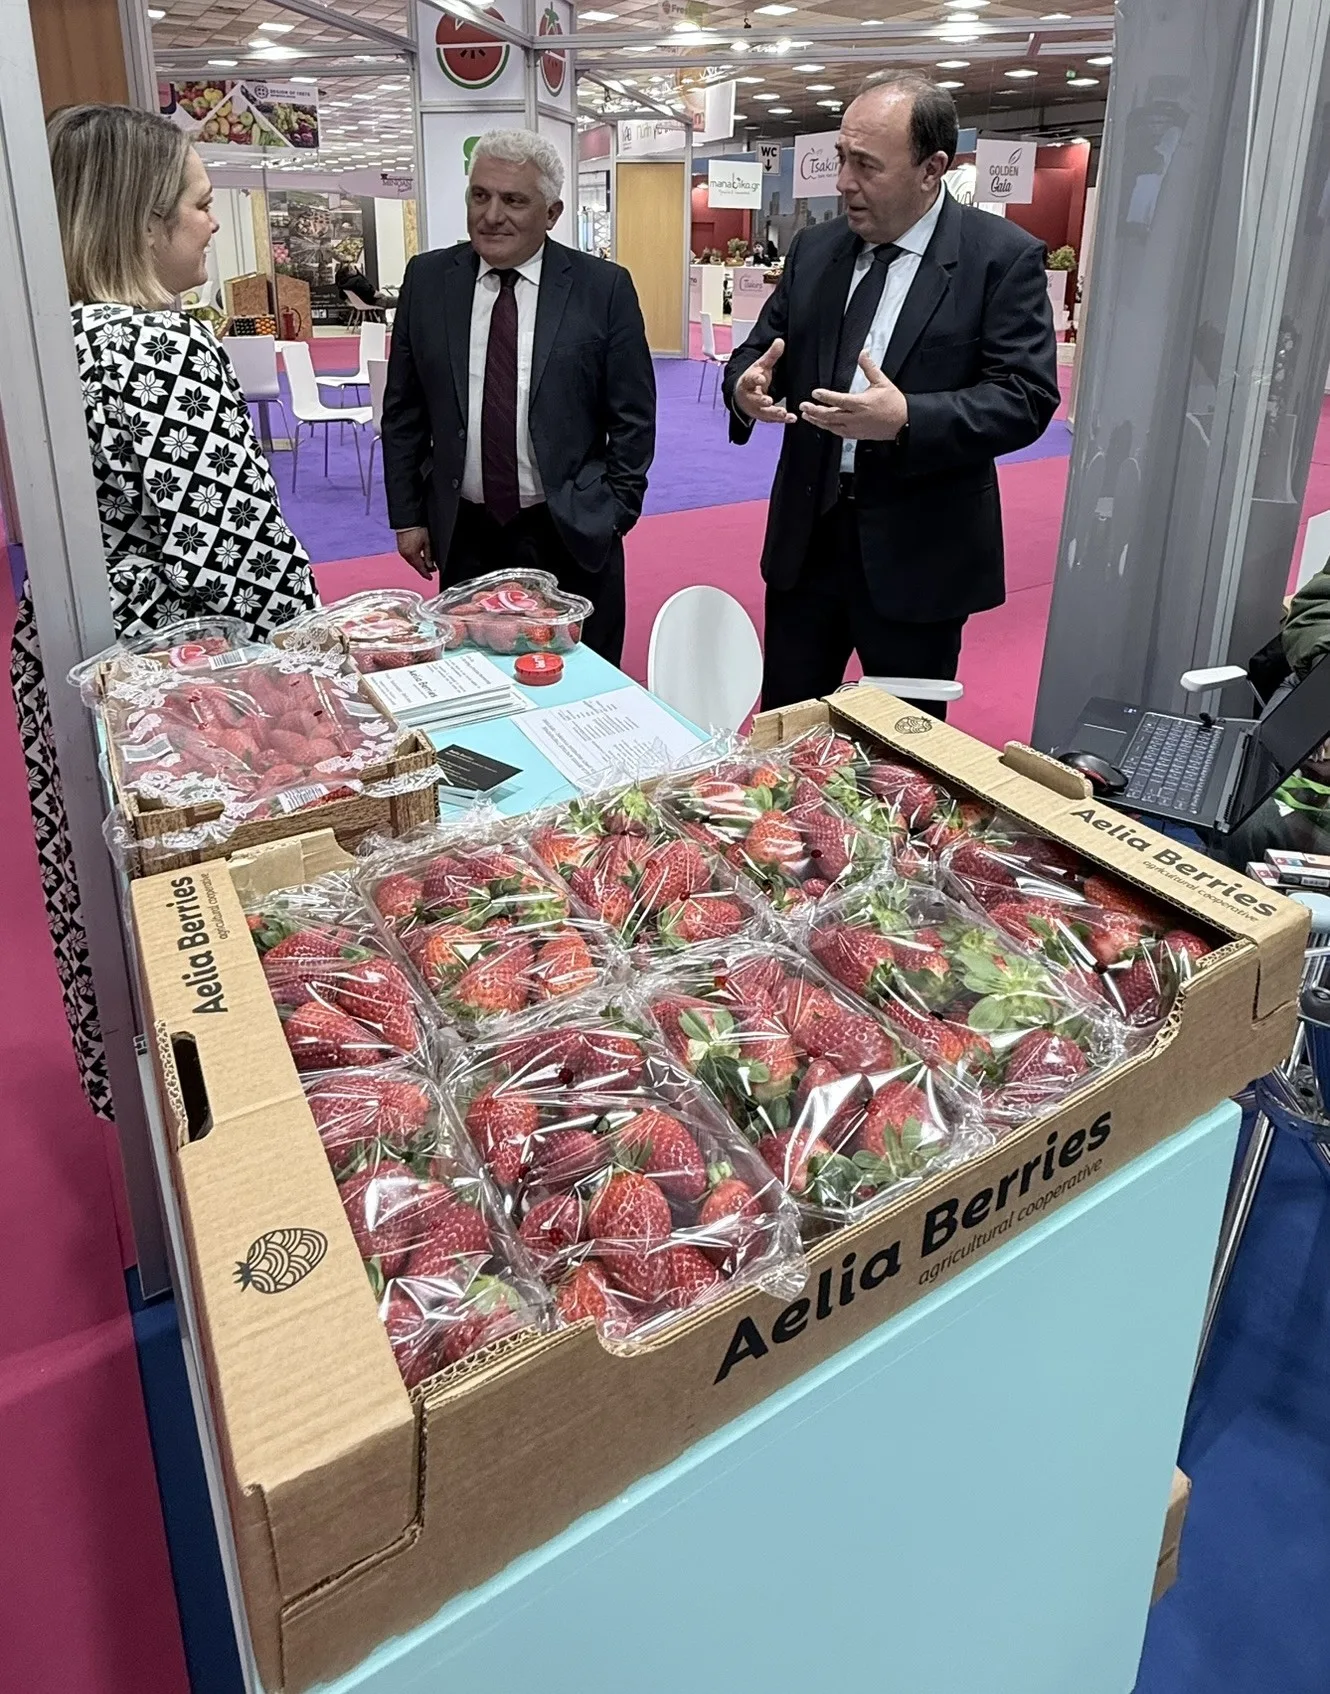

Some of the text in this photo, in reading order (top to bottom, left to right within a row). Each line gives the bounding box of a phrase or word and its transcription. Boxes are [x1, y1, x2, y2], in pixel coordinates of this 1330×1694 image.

[760, 146, 778, 158] WC
[989, 165, 1019, 177] GOLDEN
[990, 175, 1012, 193] Gaia
[1070, 808, 1278, 917] Aelia Berries
[1142, 860, 1260, 922] agricultural cooperative
[201, 872, 230, 940] agricultural cooperative
[165, 876, 229, 1014] Aelia Berries
[712, 1111, 1113, 1385] Aelia Berries
[918, 1157, 1104, 1286] agricultural cooperative
